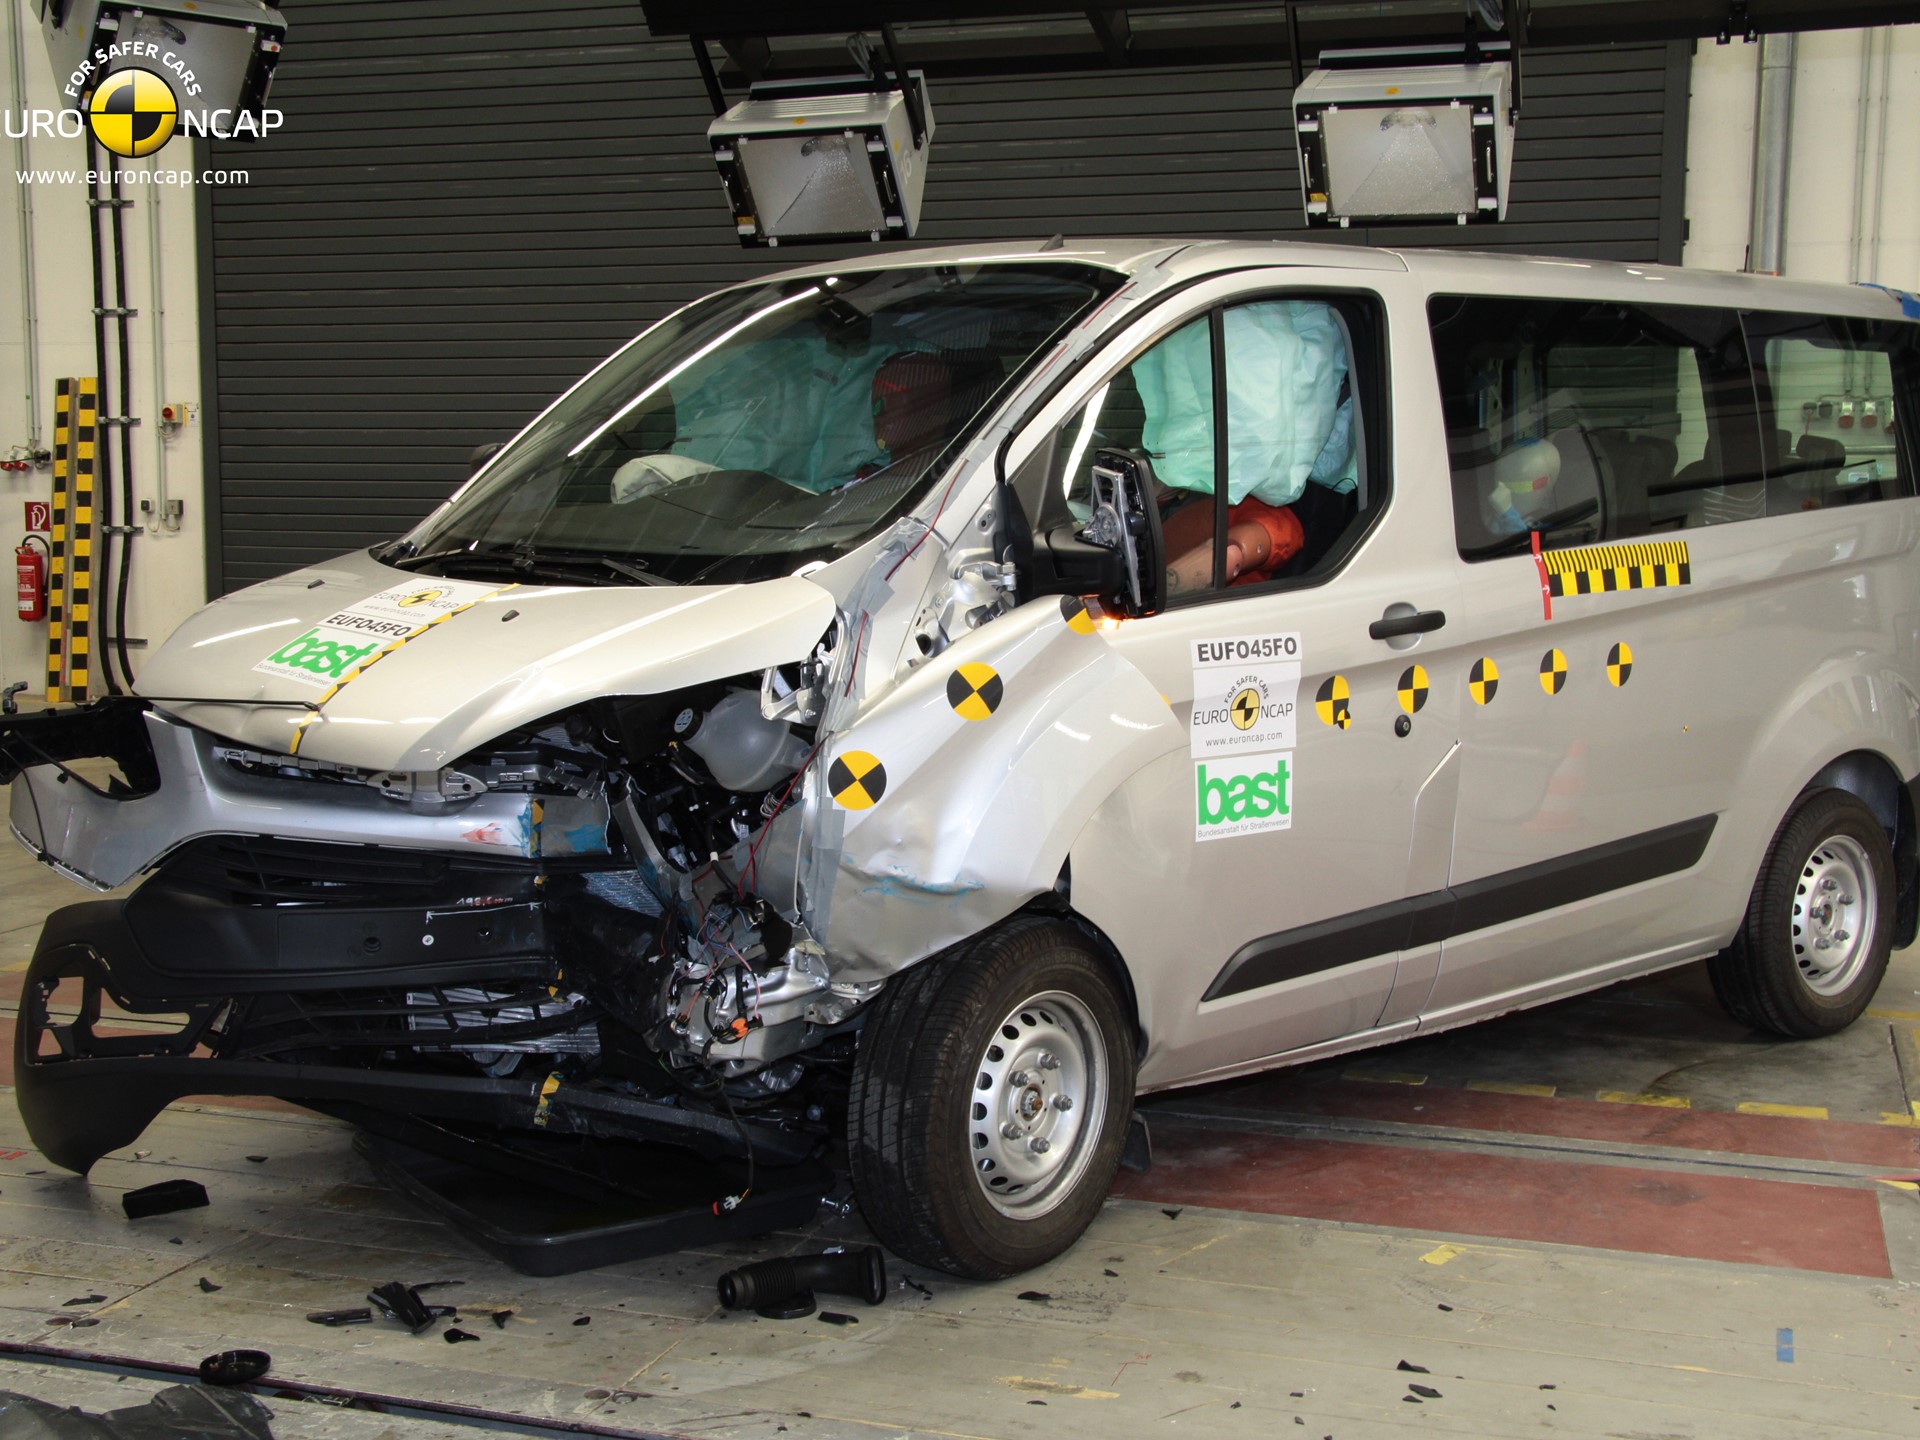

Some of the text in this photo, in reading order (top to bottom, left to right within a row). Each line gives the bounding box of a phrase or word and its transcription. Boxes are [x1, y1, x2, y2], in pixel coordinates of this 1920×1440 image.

[267, 628, 379, 678] bast
[1224, 675, 1269, 703] FOR SAFER CARS
[1193, 703, 1293, 725] EURO NCAP
[1205, 732, 1283, 747] www.euroncap.com
[1197, 760, 1290, 825] bast
[1197, 819, 1289, 838] Bundesanstalt für Straßenwesen
